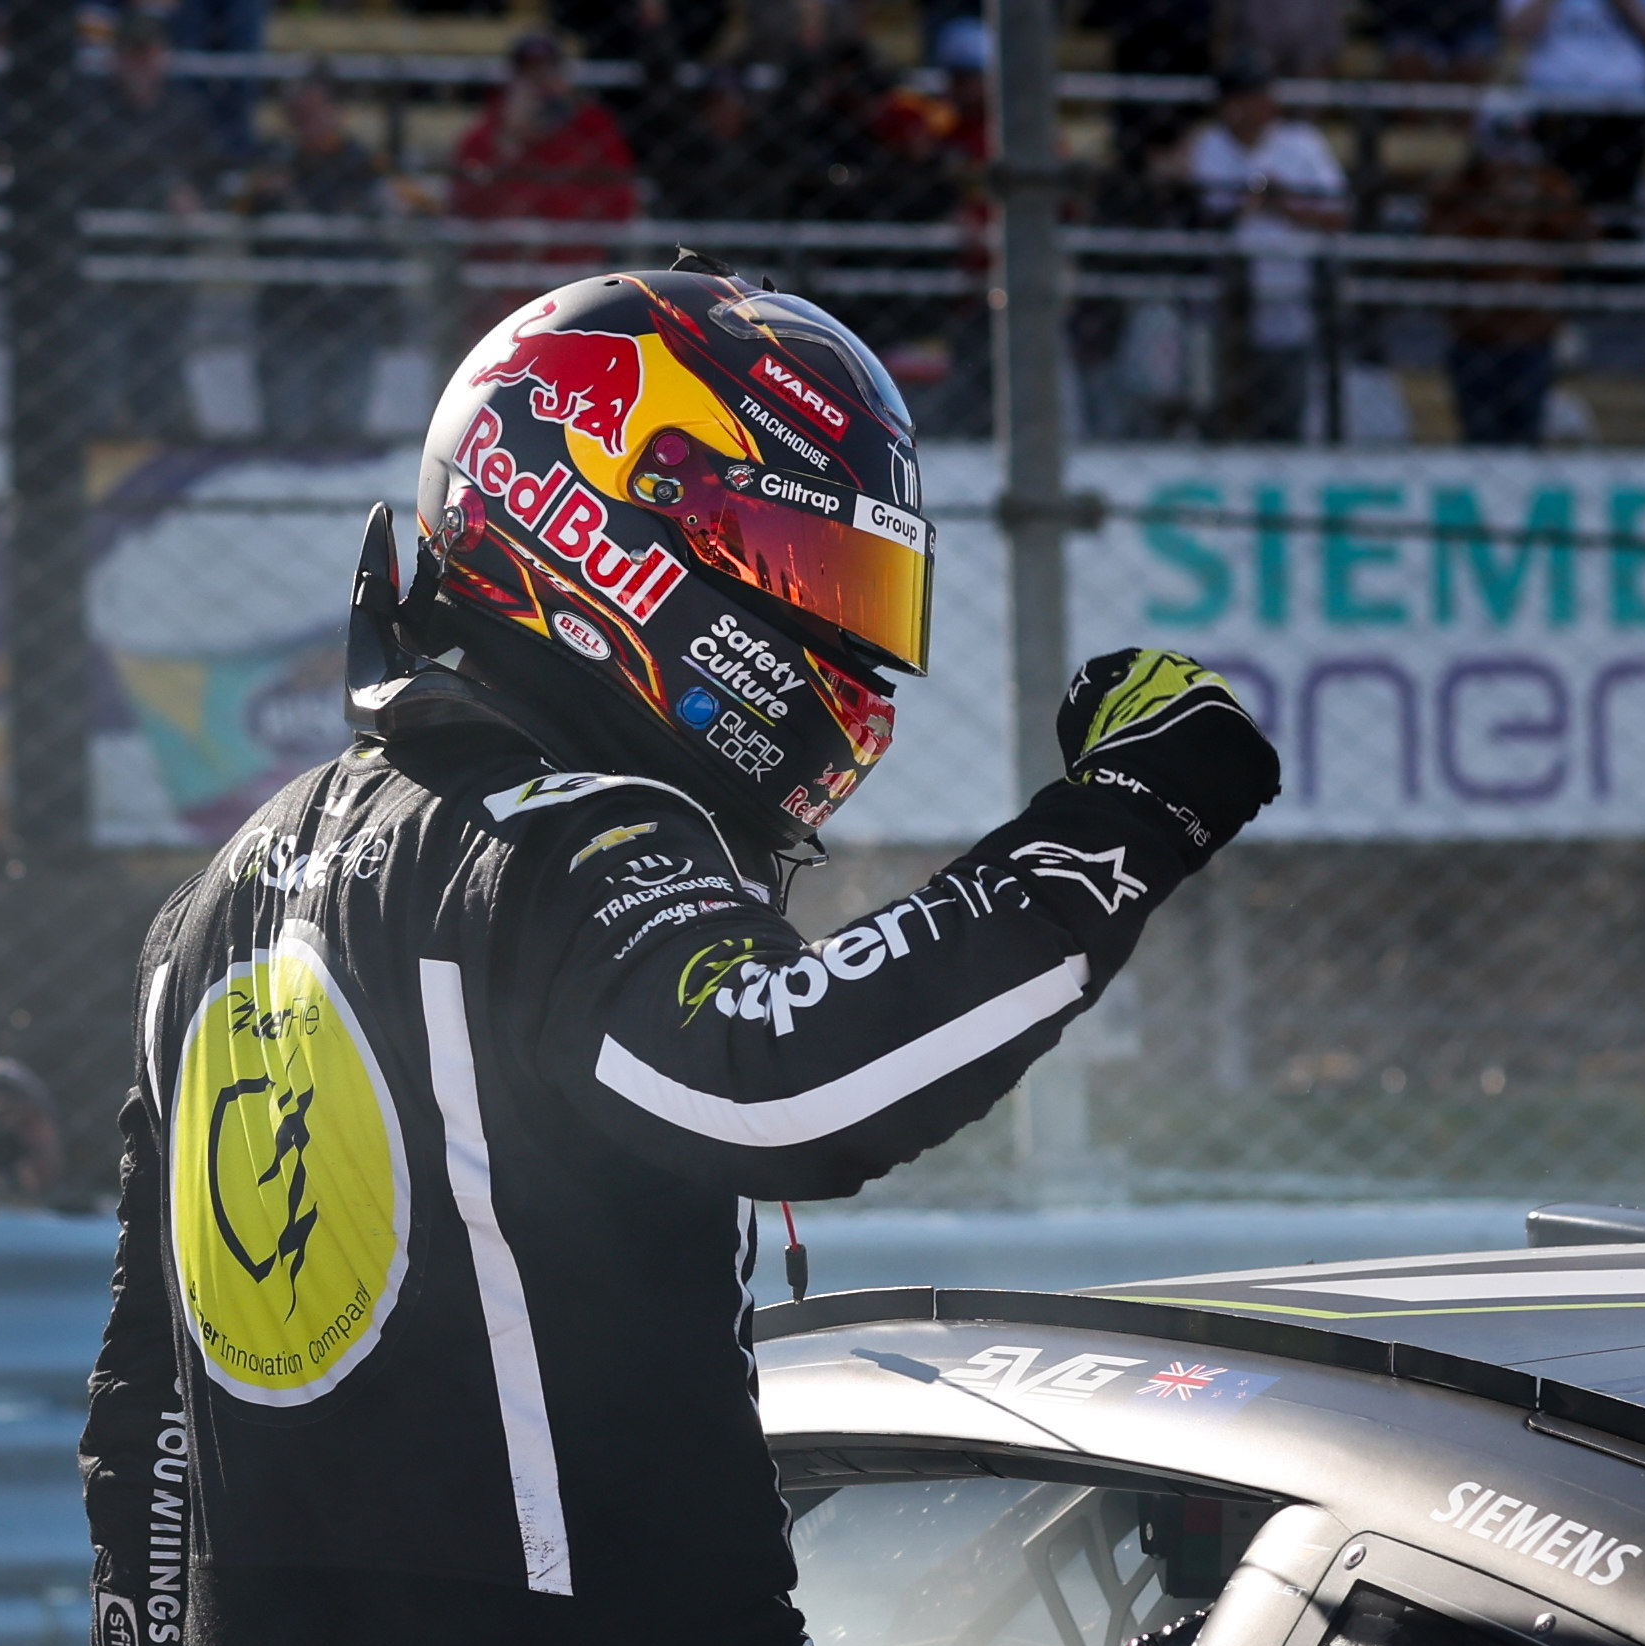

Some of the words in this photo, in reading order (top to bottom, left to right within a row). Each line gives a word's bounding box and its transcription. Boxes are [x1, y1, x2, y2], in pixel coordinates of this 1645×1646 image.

[764, 357, 844, 427] WARD
[739, 395, 831, 472] TRACKHOUSE
[760, 472, 840, 515] Giltrap
[871, 504, 918, 546] Group
[558, 616, 602, 655] BELL
[711, 614, 805, 694] Safety
[690, 636, 788, 719] Culture
[706, 725, 773, 784] LOCK
[719, 710, 785, 767] QUAD
[593, 876, 734, 927] TRACKHOUSE
[221, 1333, 304, 1376] Innovation
[308, 1278, 372, 1365] Company
[938, 1345, 1149, 1402] SVG
[1430, 1481, 1643, 1587] SIEMENS
